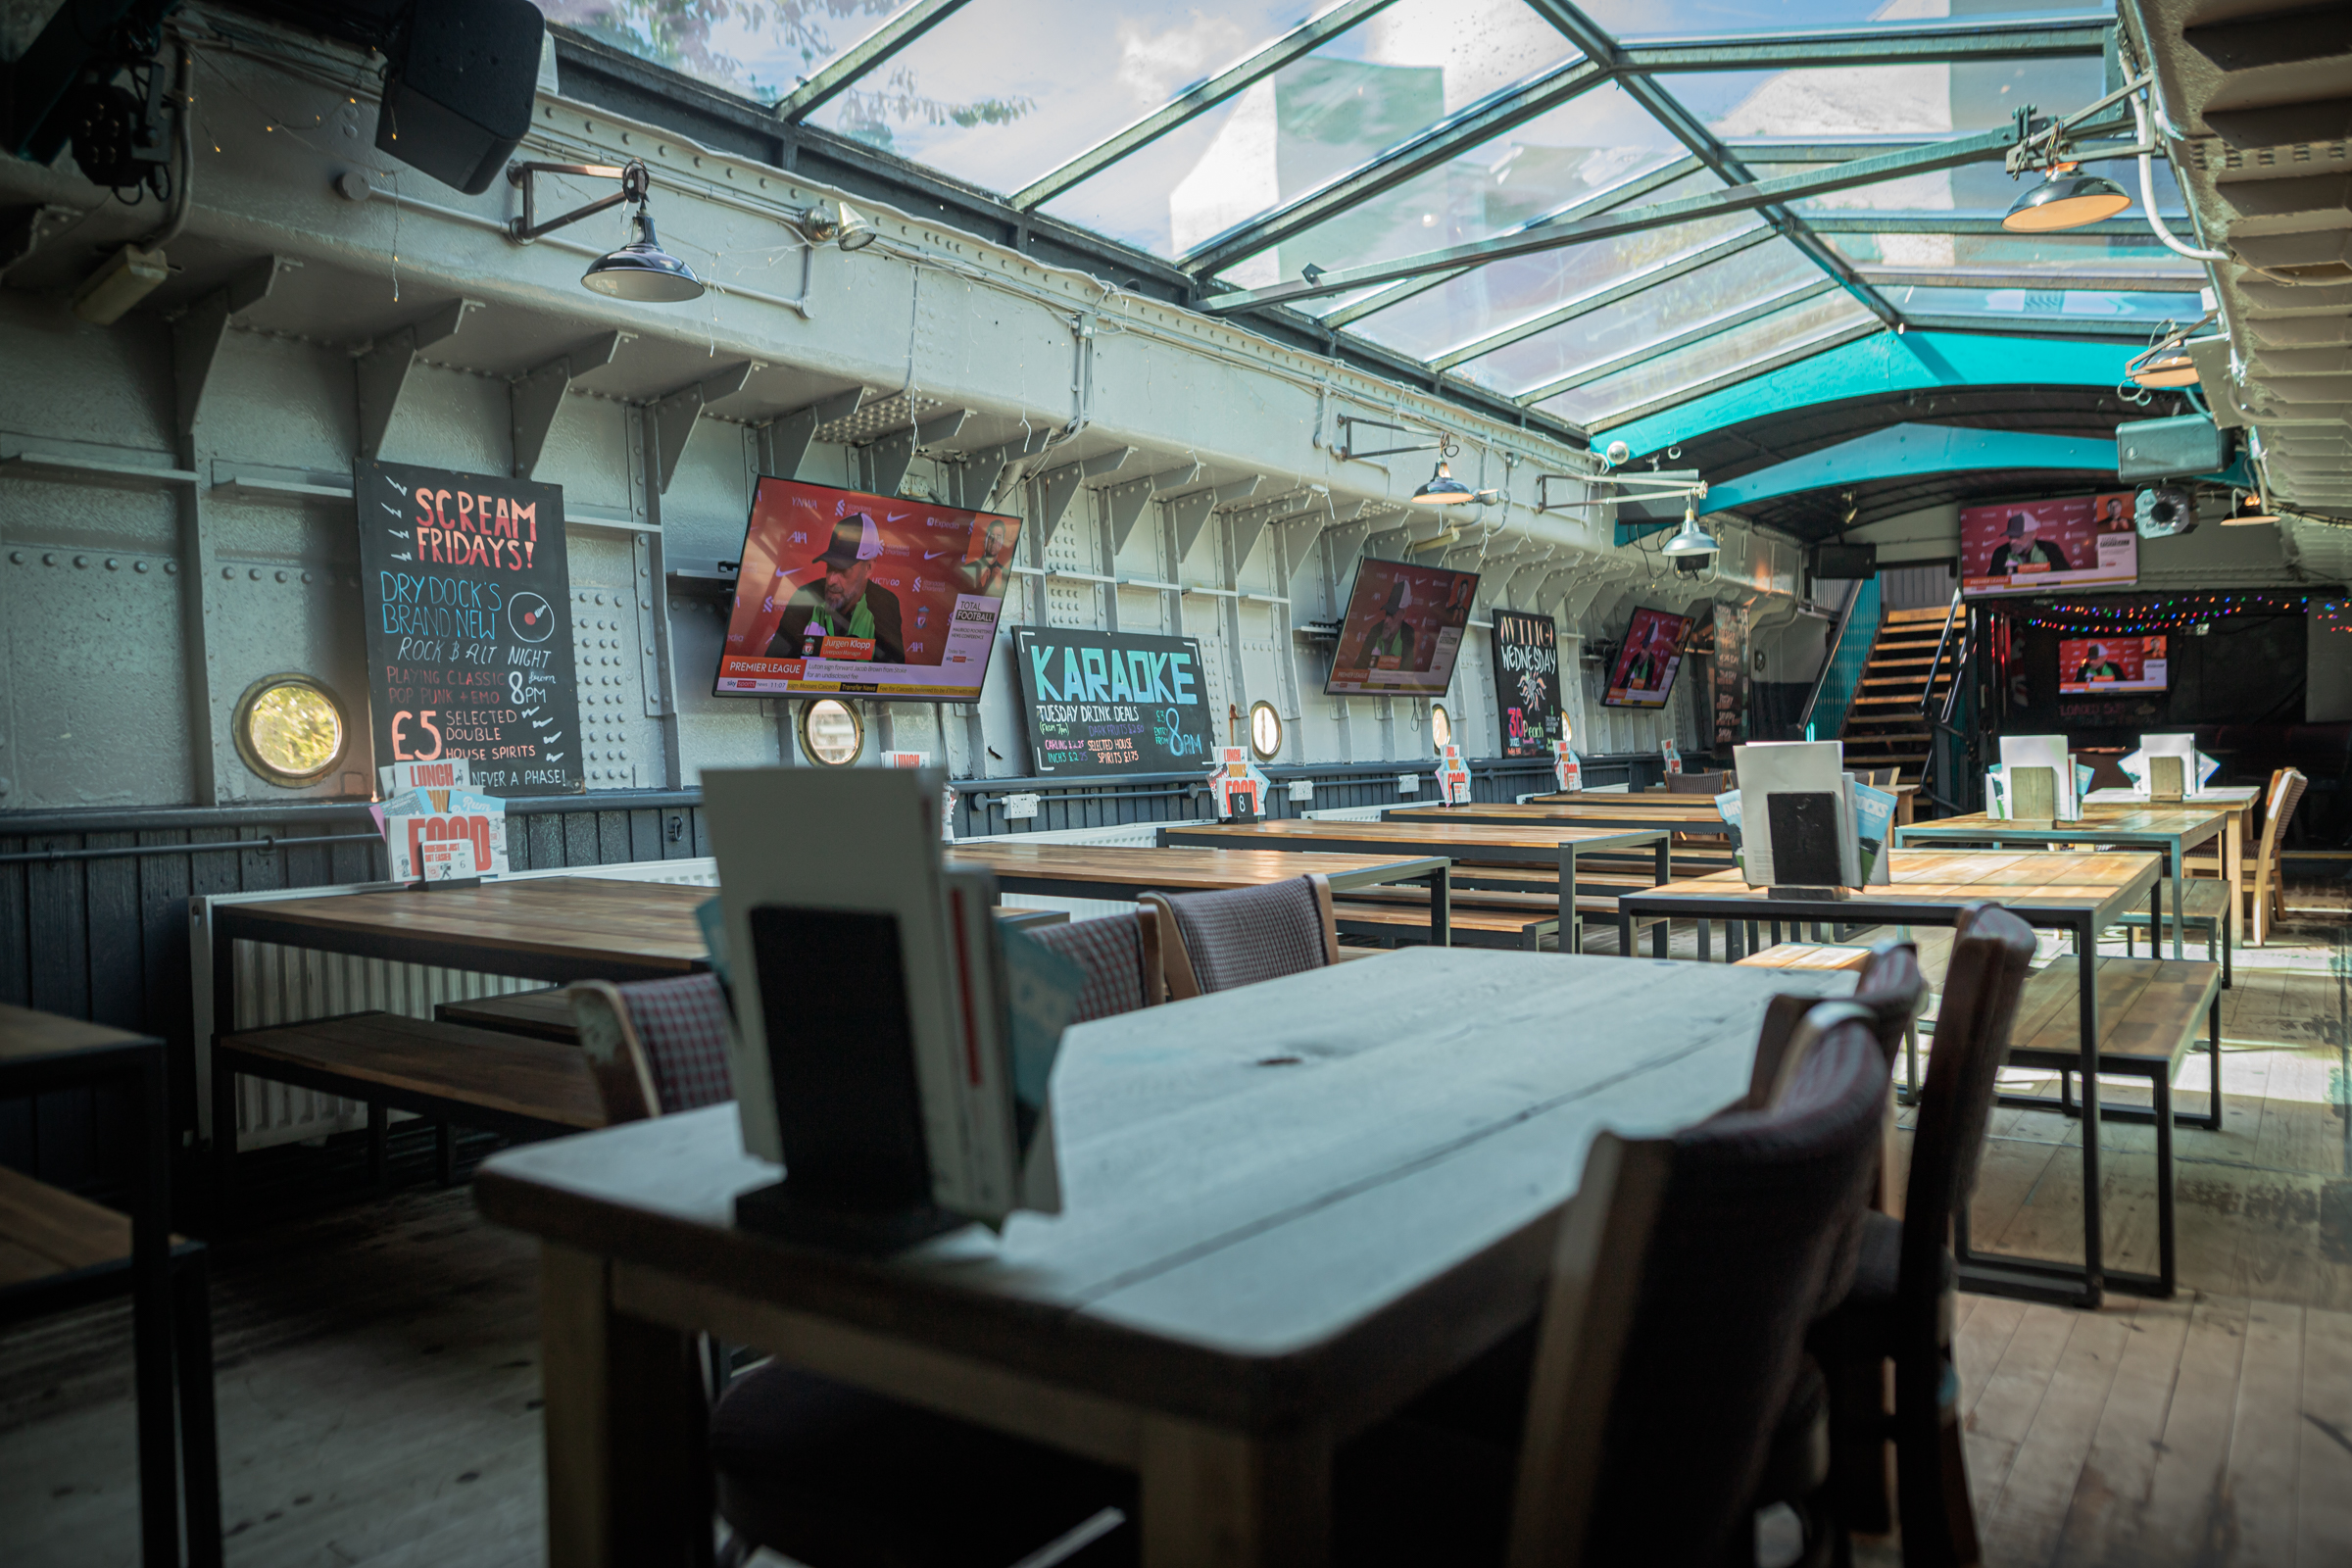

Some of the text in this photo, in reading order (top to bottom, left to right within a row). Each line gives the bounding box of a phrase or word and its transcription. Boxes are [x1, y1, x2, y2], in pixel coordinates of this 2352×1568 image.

[791, 497, 818, 509] YNWA
[416, 488, 537, 541] SCREAM
[934, 519, 960, 529] Expedia
[787, 531, 807, 544] AXA
[416, 527, 534, 570] FRIDAYS!
[381, 571, 502, 611] DRY DOCK'S
[961, 601, 981, 611] TOTAL
[382, 603, 495, 639] BRAND NEW
[957, 611, 993, 622] FOOTBALL
[1502, 616, 1550, 647] WING
[824, 638, 871, 650] Jurgen Klopp
[906, 642, 924, 653] AXA
[397, 637, 445, 662] ROCK
[466, 643, 497, 664] ALT
[508, 646, 551, 668] NIGHT
[1501, 644, 1556, 675] WEDNESDAY
[729, 662, 802, 674] PREMIER LEAGUE
[1030, 645, 1198, 705] KARAOKE
[387, 666, 505, 686] PLAYING CLASSIC
[529, 671, 556, 684] from
[389, 687, 413, 704] POP
[420, 687, 453, 704] PUNK
[471, 690, 499, 704] EMO
[446, 709, 517, 726] SELECTED
[1036, 704, 1139, 722] TUESDAY DRINK DEALS
[1156, 710, 1166, 723] £3
[392, 710, 441, 761] £5
[446, 727, 501, 741] DOUBLE
[1088, 725, 1107, 737] DARK
[1107, 724, 1127, 735] FRUITS
[1045, 739, 1068, 750] CARLING
[1087, 737, 1133, 751] SELECTED HOUSE
[1155, 736, 1169, 745] FROM
[446, 745, 536, 760] HOUSE SPIRITS
[1097, 752, 1123, 764] SPIRITS
[1224, 748, 1241, 762] LUNCH
[894, 754, 920, 768] LUNCH
[410, 763, 454, 787] LUNCH
[472, 769, 566, 788] NEVER A PHASE!
[463, 796, 491, 811] Rum
[1238, 794, 1246, 812] 8
[460, 860, 466, 869] 6
